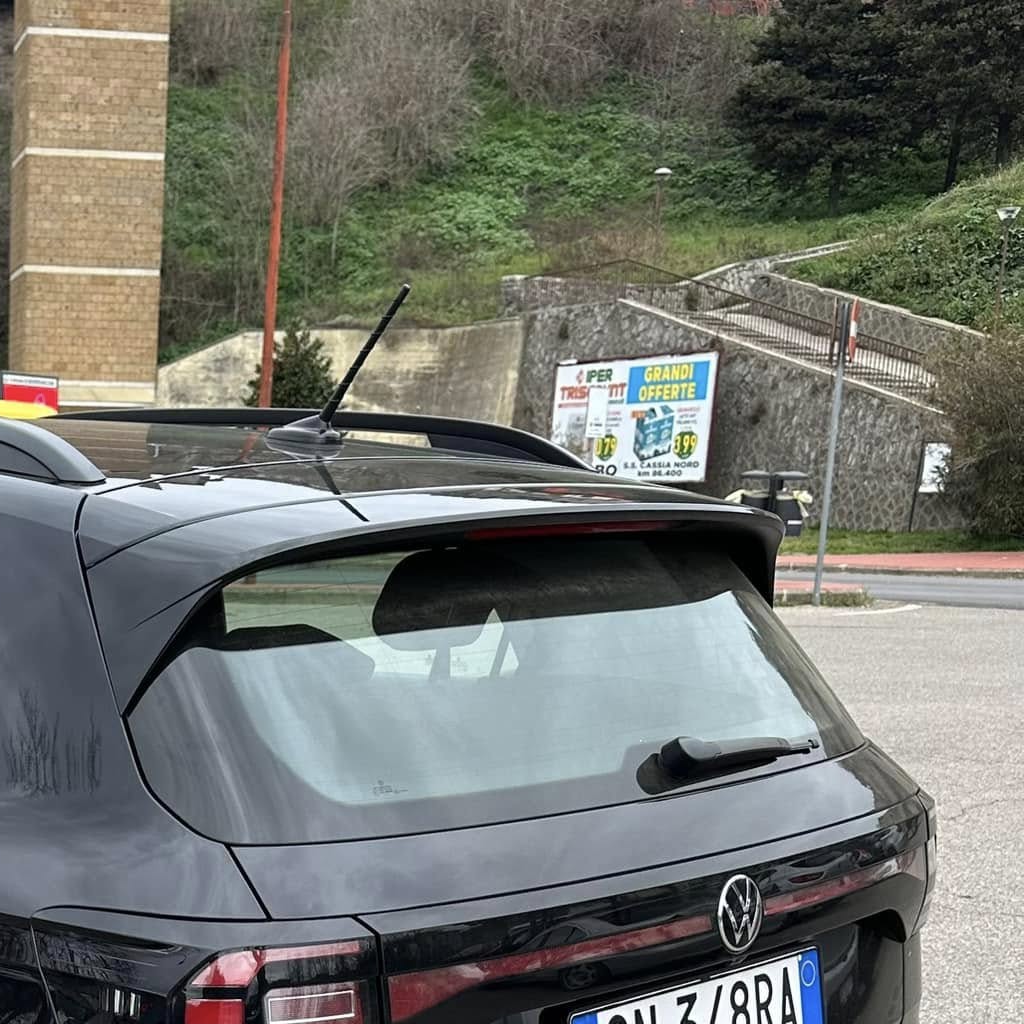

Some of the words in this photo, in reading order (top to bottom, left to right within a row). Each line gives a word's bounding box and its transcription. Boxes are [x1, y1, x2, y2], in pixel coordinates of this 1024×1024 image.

[586, 367, 613, 383] IPER
[644, 363, 694, 383] GRANDI
[638, 382, 696, 402] OFFERTE
[674, 460, 700, 468] NORD
